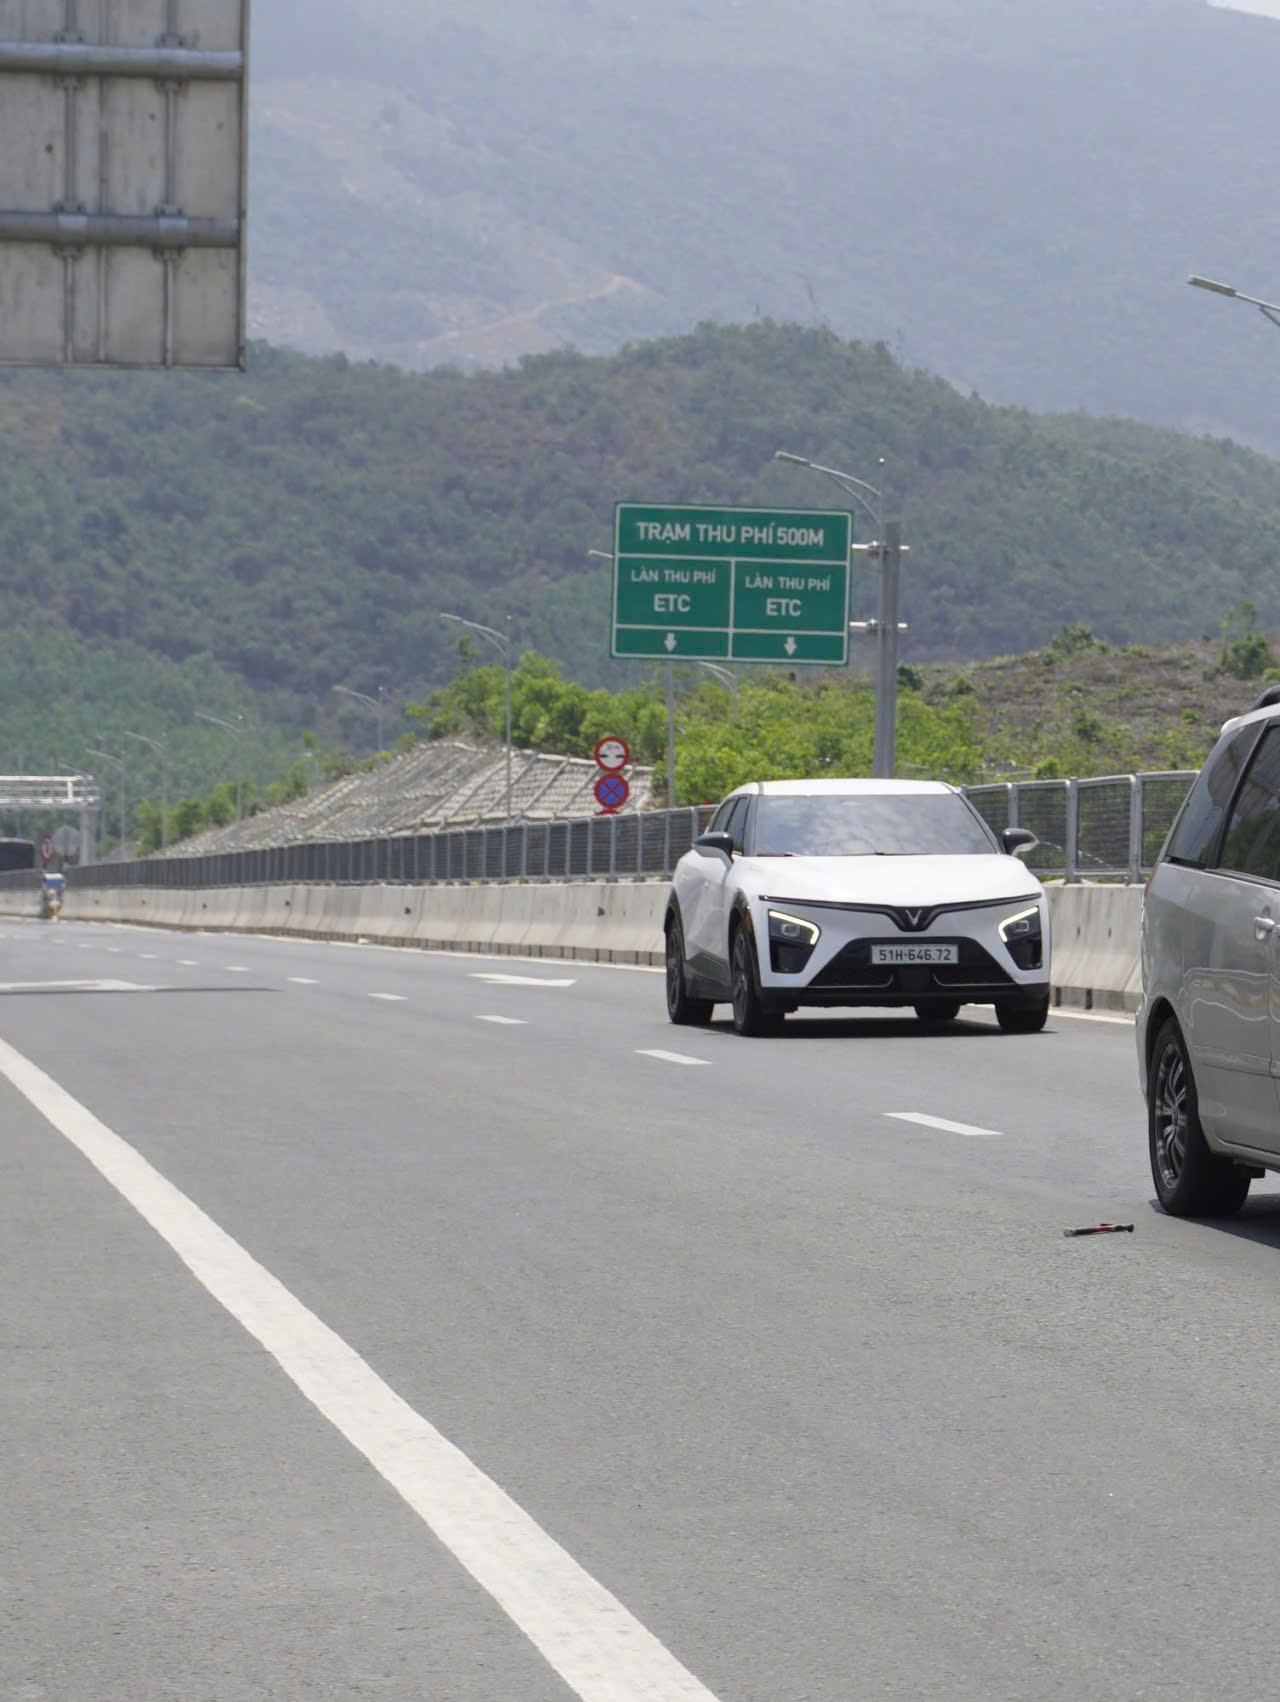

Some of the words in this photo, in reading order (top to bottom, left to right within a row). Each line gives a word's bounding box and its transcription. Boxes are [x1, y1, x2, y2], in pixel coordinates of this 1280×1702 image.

[636, 522, 690, 544] TRẠM
[696, 524, 735, 543] THU
[741, 522, 775, 544] PHÍ
[777, 527, 824, 547] 500M
[664, 569, 690, 583] THU
[694, 568, 717, 584] PHÍ
[777, 576, 805, 590] THU
[808, 574, 831, 591] PHÍ
[654, 594, 691, 612] ETC
[766, 598, 801, 616] ETC
[880, 948, 951, 961] 51H-646.72
